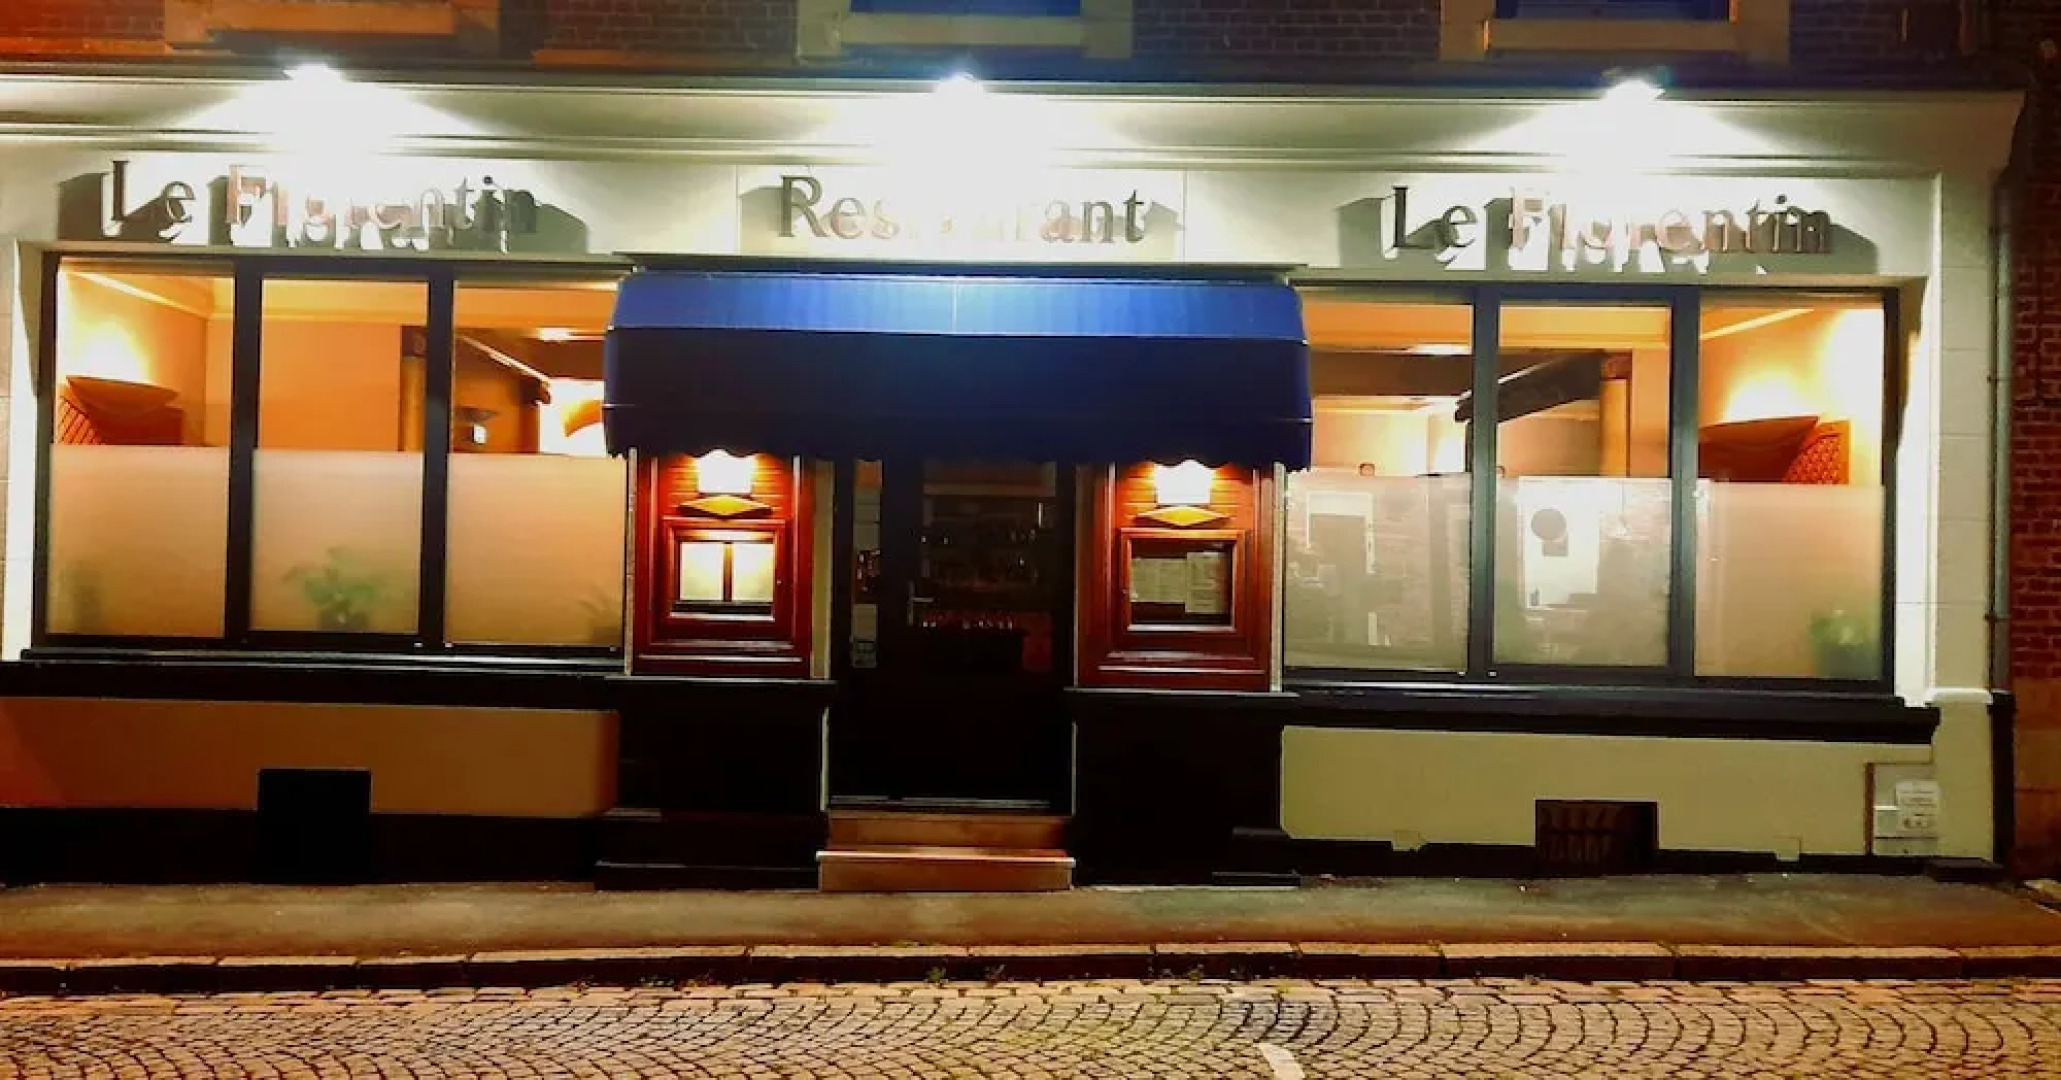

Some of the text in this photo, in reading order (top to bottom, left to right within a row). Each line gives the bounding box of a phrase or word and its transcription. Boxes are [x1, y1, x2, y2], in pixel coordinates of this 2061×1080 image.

[111, 159, 196, 223] Le
[777, 174, 1147, 245] Resrant
[1391, 185, 1479, 249] Le
